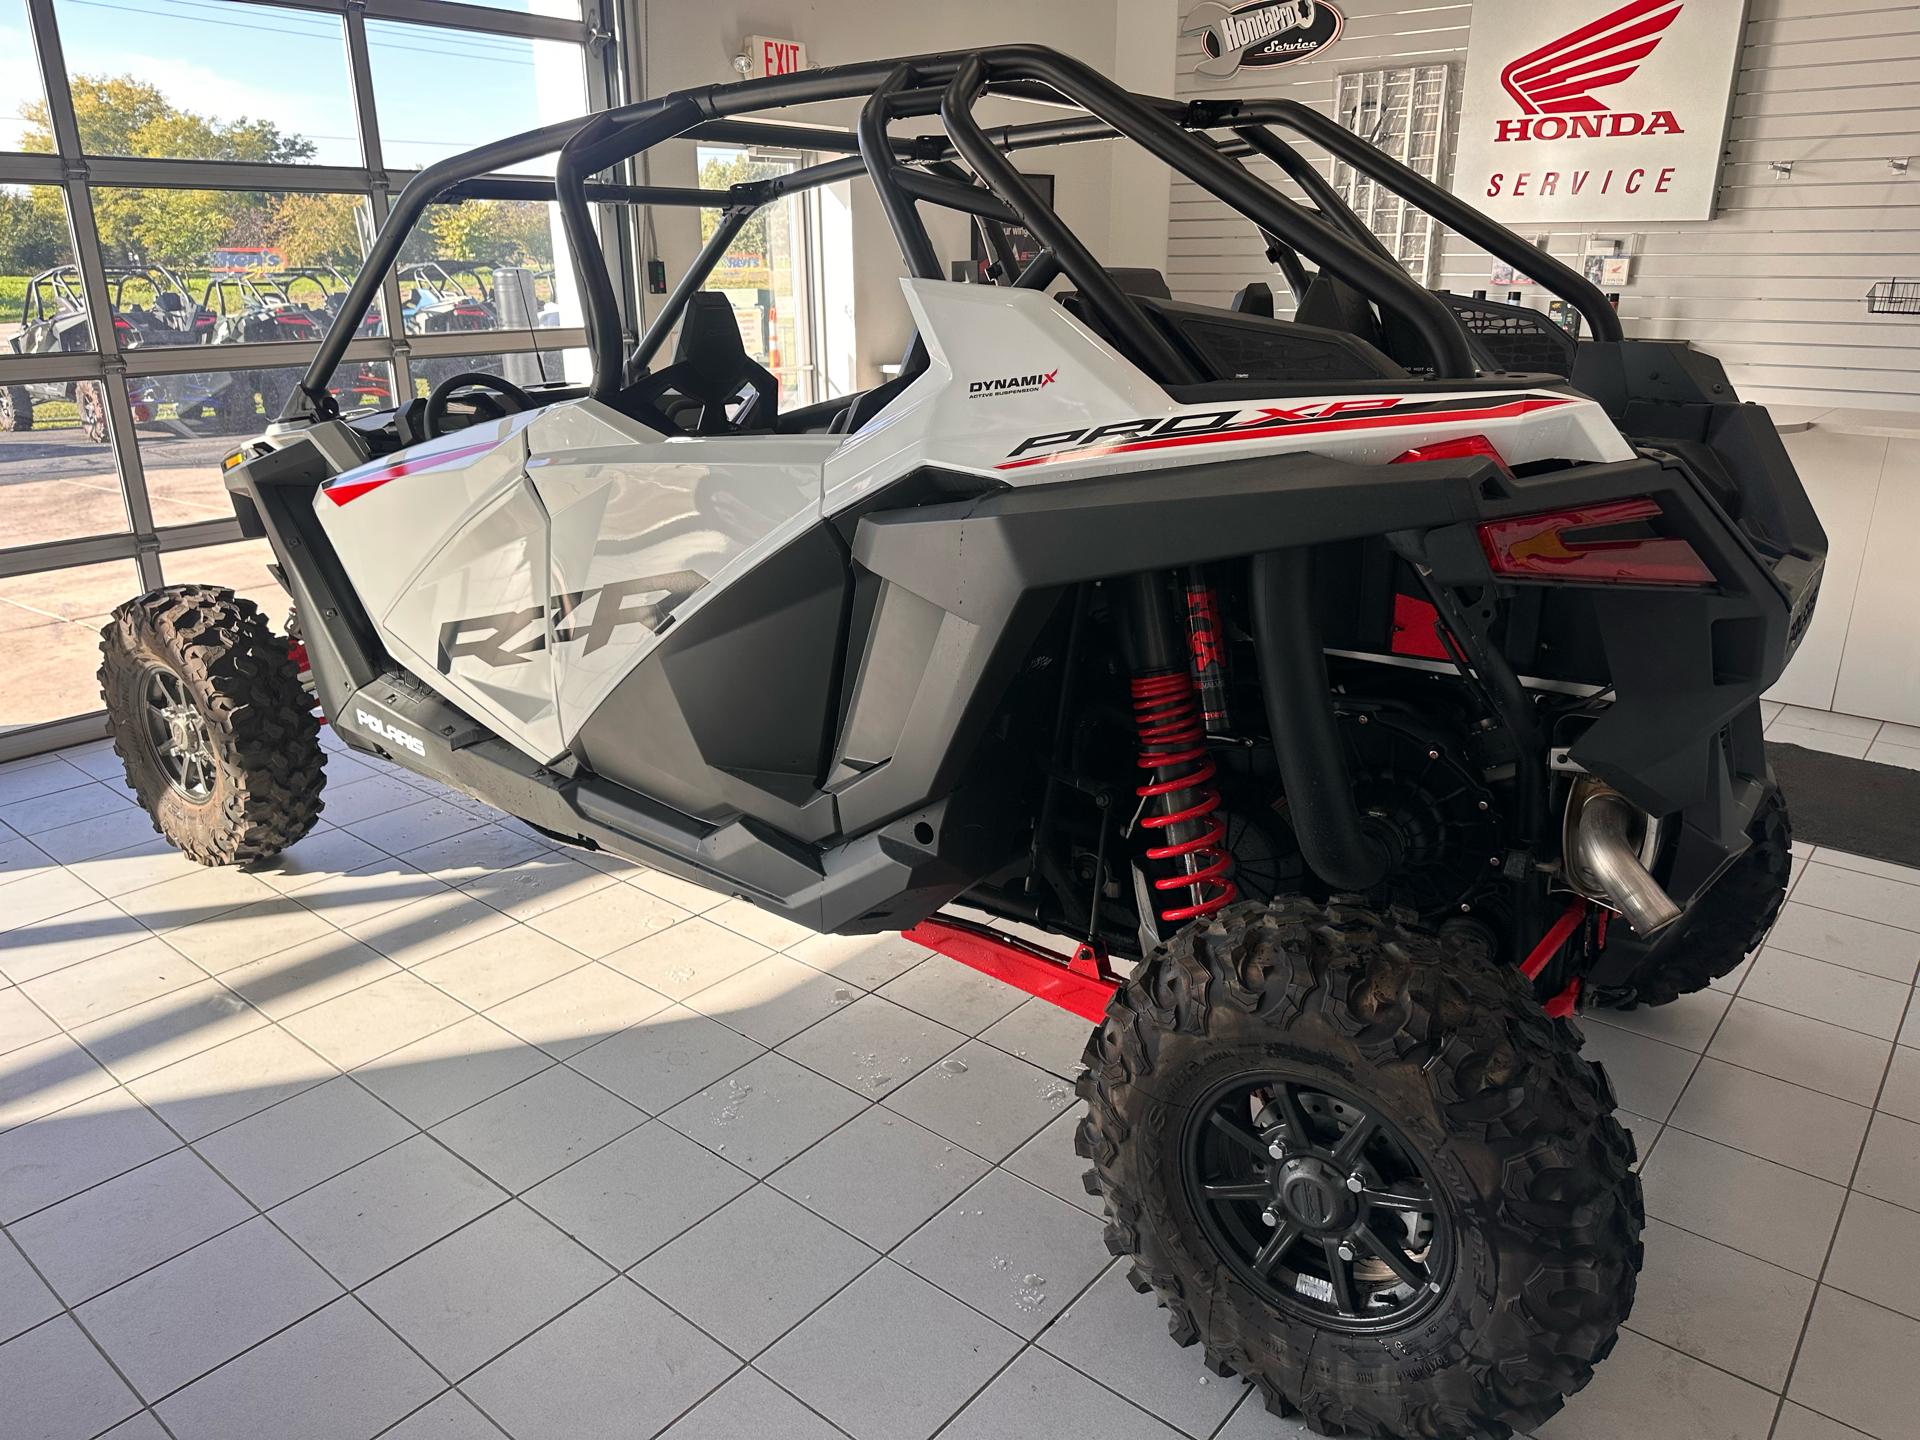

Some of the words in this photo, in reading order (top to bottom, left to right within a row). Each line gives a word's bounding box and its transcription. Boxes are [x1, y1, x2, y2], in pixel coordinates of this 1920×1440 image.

[1220, 5, 1297, 52] HondaPro
[764, 41, 799, 77] EXIT
[1263, 38, 1319, 53] Service
[1494, 111, 1685, 142] HONDA
[1487, 168, 1676, 197] SERVICE
[242, 262, 285, 280] Sports
[969, 368, 1058, 393] DYNAMIX
[994, 386, 1040, 397] SUSPENSION
[437, 569, 711, 676] RZR
[1184, 588, 1226, 672] FOX
[355, 708, 426, 757] POLARIS
